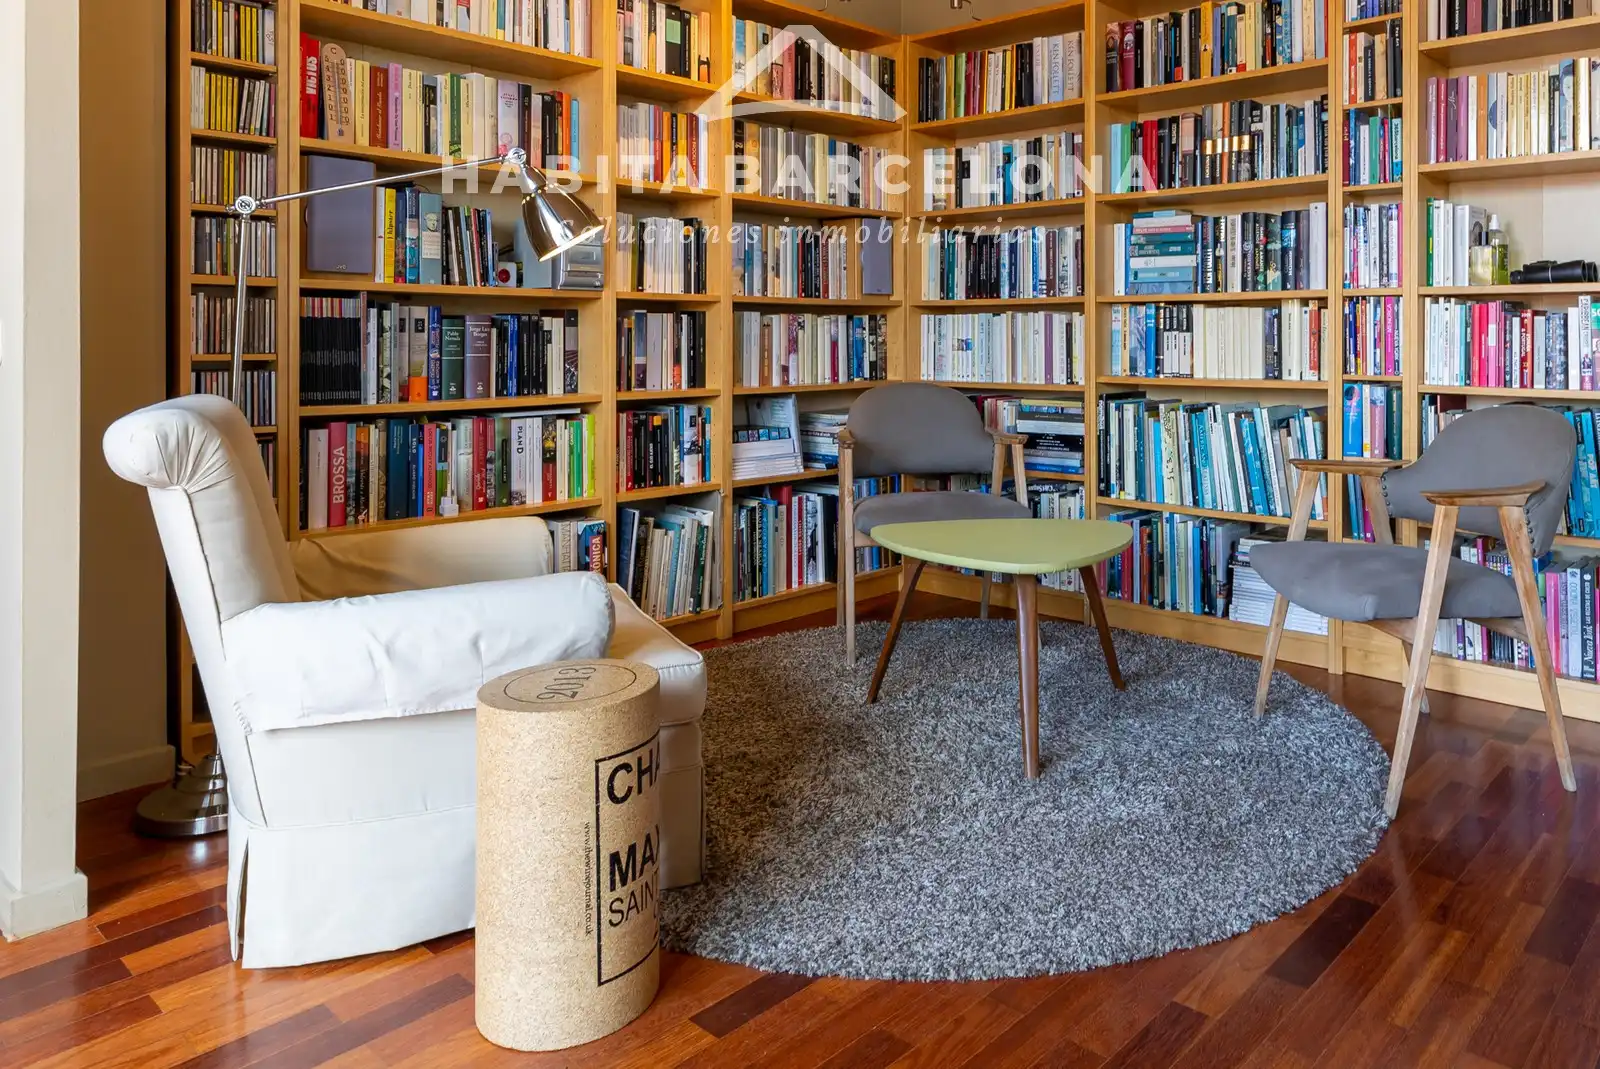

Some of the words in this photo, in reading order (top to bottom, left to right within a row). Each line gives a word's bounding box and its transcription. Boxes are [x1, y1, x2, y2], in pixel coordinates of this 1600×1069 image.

[333, 446, 345, 504] BROSSA
[536, 667, 596, 699] 2013
[584, 821, 595, 937] www.thewinejournal.co.uk
